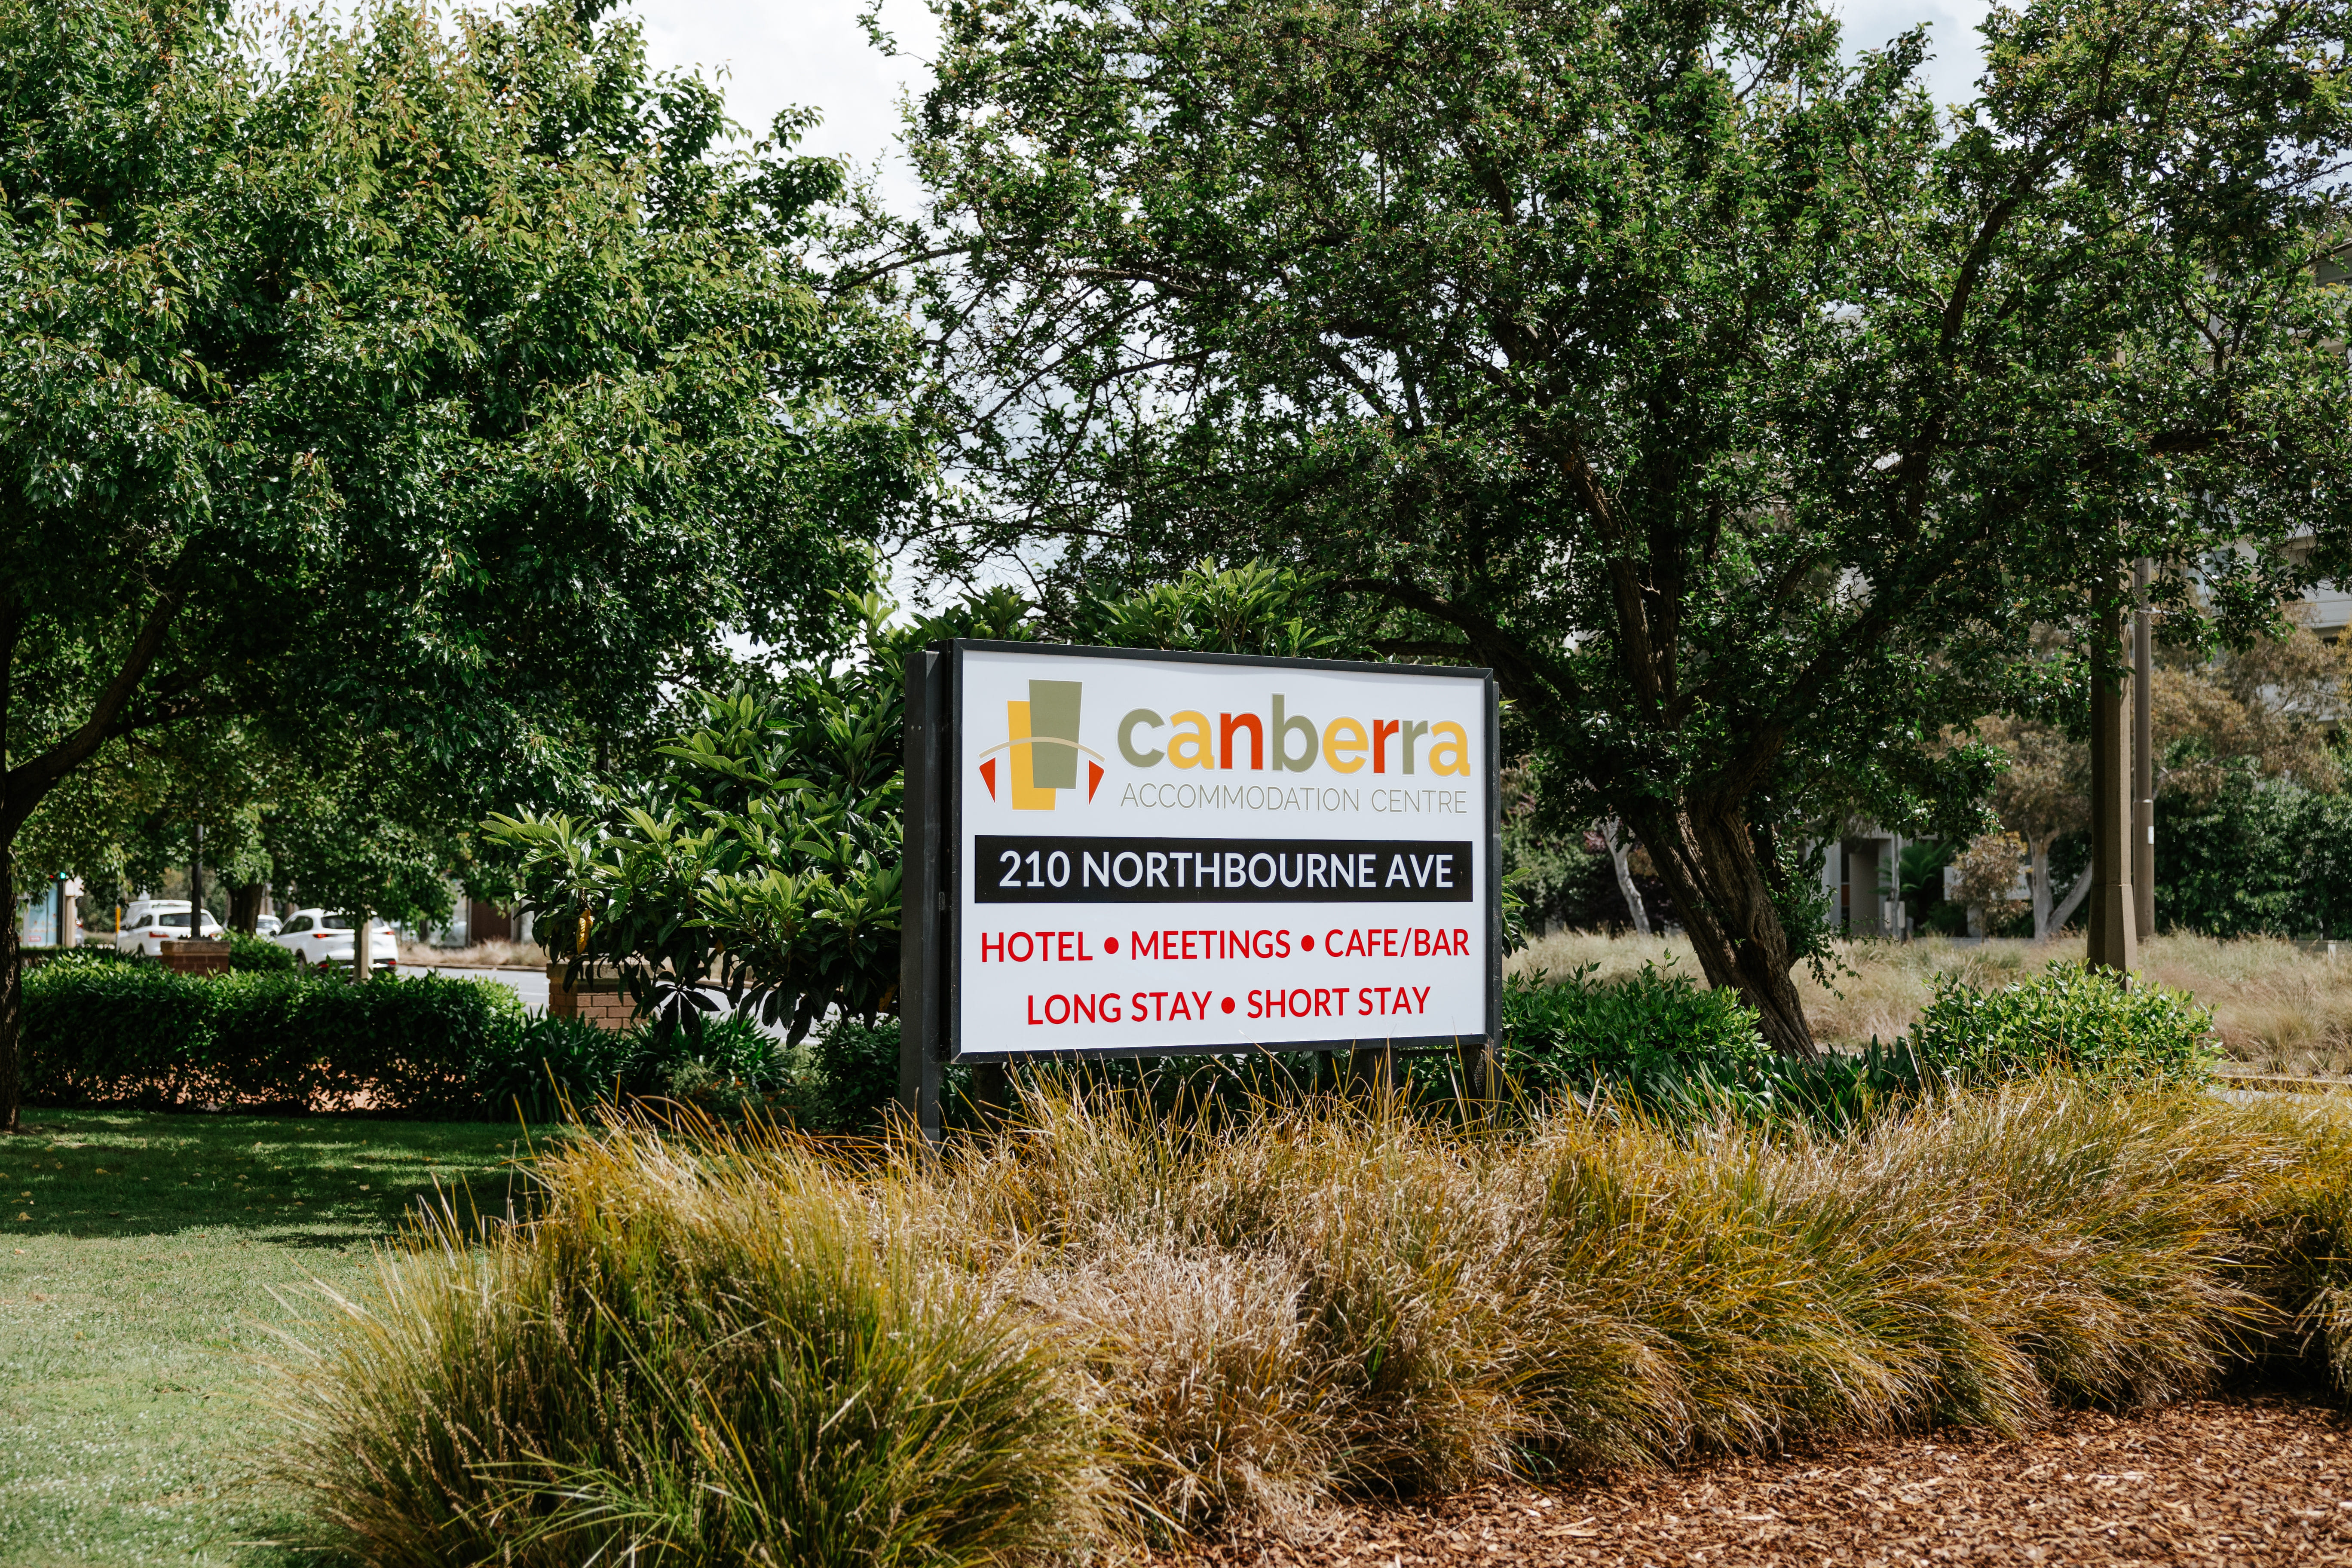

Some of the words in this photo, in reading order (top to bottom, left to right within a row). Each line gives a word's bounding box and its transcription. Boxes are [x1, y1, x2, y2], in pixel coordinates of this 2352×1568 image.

[1118, 693, 1470, 777] canberra
[1120, 783, 1359, 812] ACCOMMODATION
[1371, 789, 1467, 814] CENTRE
[999, 850, 1070, 888] 210
[1083, 851, 1377, 888] NORTHBOURNE
[1384, 854, 1454, 888] AVE
[982, 931, 1093, 963] HOTEL
[1131, 929, 1291, 960] MEETINGS
[1325, 927, 1470, 958] CAFE/BAR
[1028, 992, 1121, 1025] LONG
[1131, 991, 1213, 1022] STAY
[1247, 987, 1350, 1019] SHORT
[1358, 986, 1431, 1016] STAY
